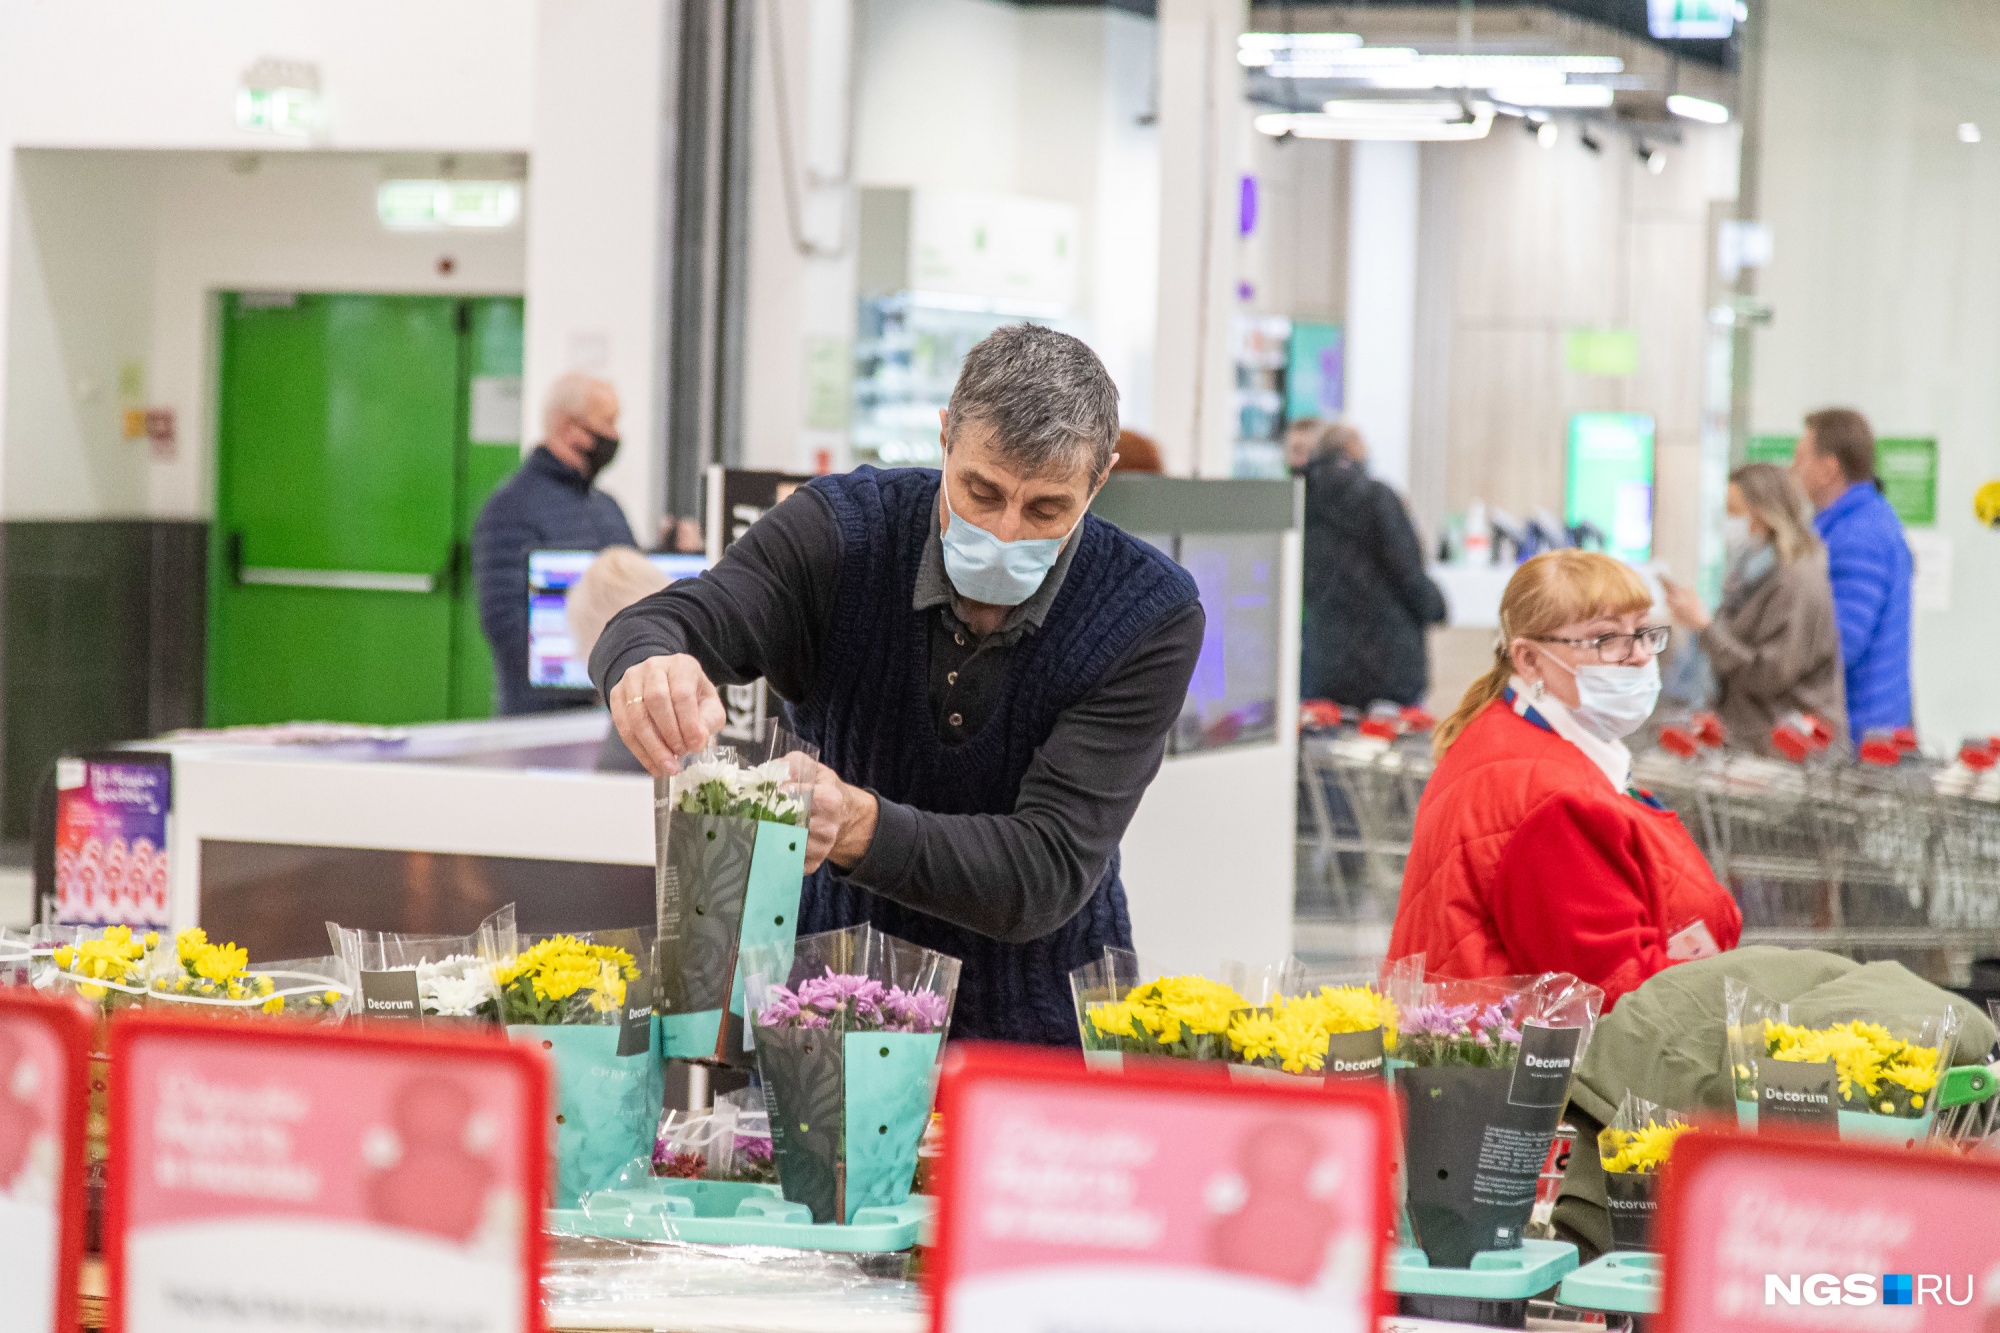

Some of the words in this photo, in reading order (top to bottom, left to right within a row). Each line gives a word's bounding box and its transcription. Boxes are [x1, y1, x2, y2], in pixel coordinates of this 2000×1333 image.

[367, 998, 414, 1010] Decorum
[628, 1005, 652, 1020] Decoru
[1525, 1054, 1571, 1068] Decorum
[1766, 1087, 1829, 1104] Decorum
[1607, 1196, 1658, 1209] Decorum
